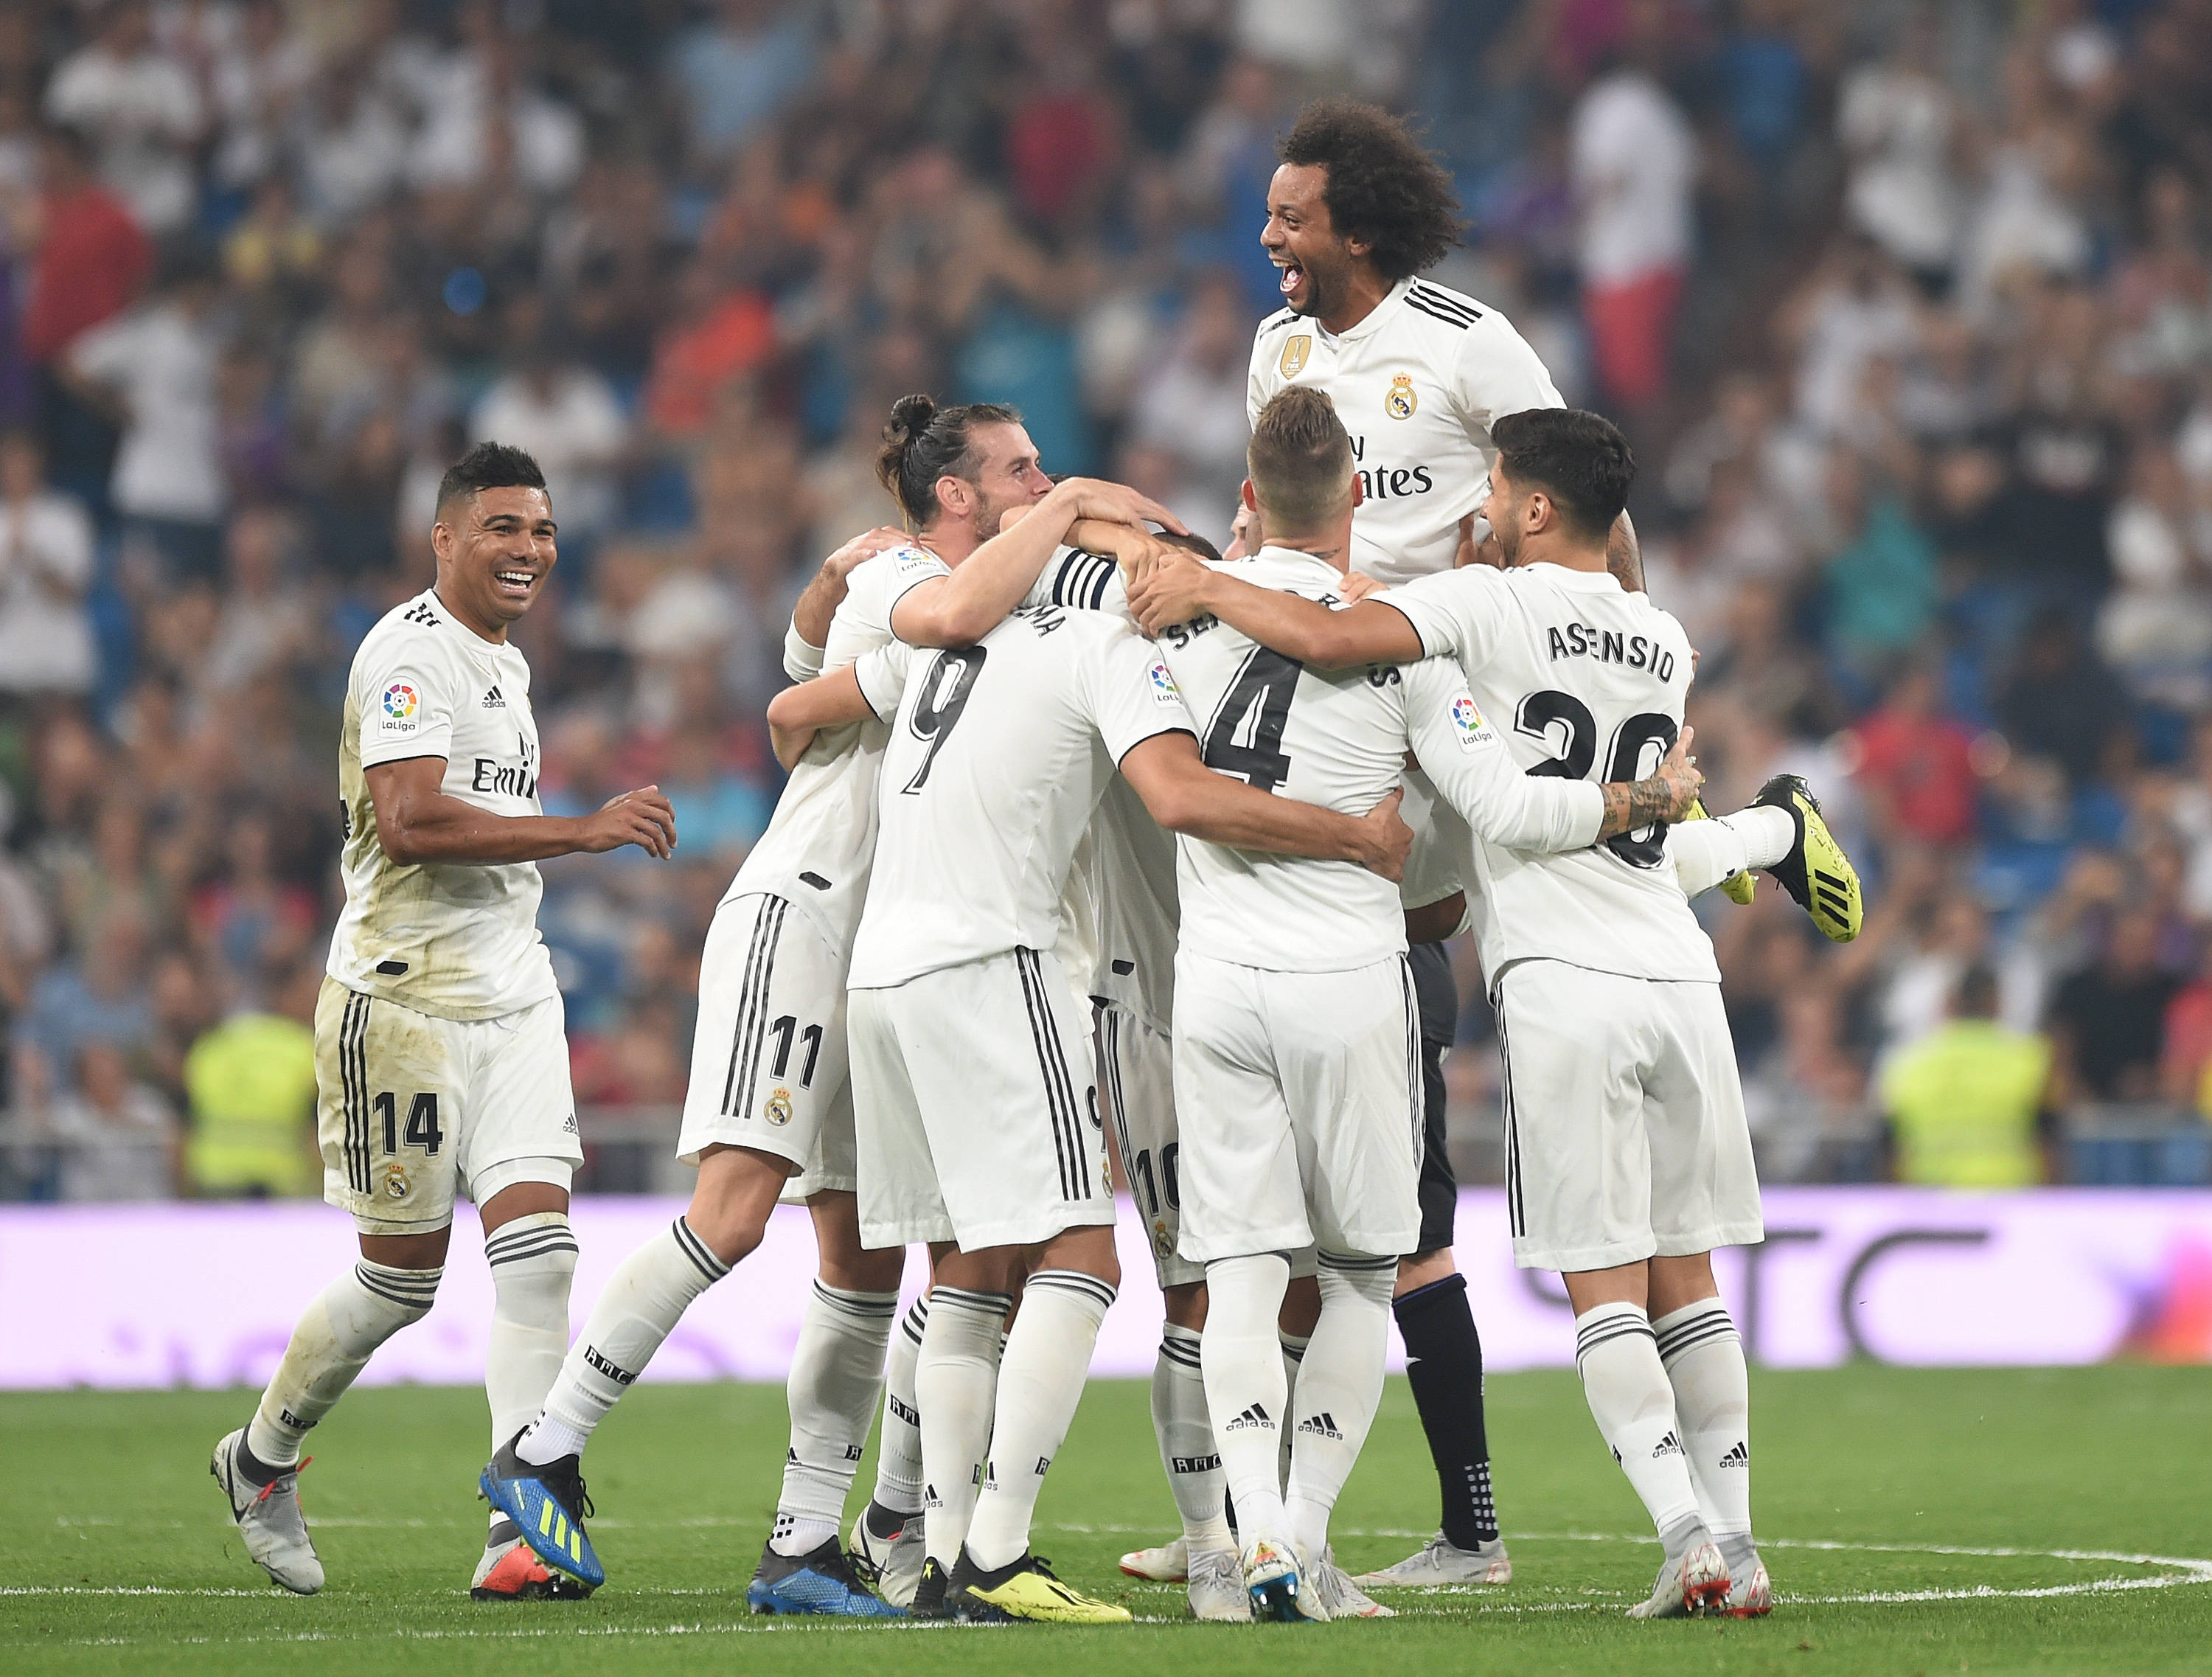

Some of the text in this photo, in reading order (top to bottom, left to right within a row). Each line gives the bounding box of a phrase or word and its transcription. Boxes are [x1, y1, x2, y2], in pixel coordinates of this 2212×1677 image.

[1357, 464, 1432, 499] ates
[1548, 622, 1674, 684] ASENSIO
[482, 700, 506, 708] adidas
[900, 646, 987, 795] 9
[1201, 645, 1303, 794] 4
[382, 721, 415, 732] LaLiga
[1463, 732, 1492, 745] LaLiga
[769, 1015, 824, 1090] 11
[372, 1091, 442, 1156] 14
[1225, 1417, 1276, 1431] adidas
[1298, 1423, 1343, 1440] adidas
